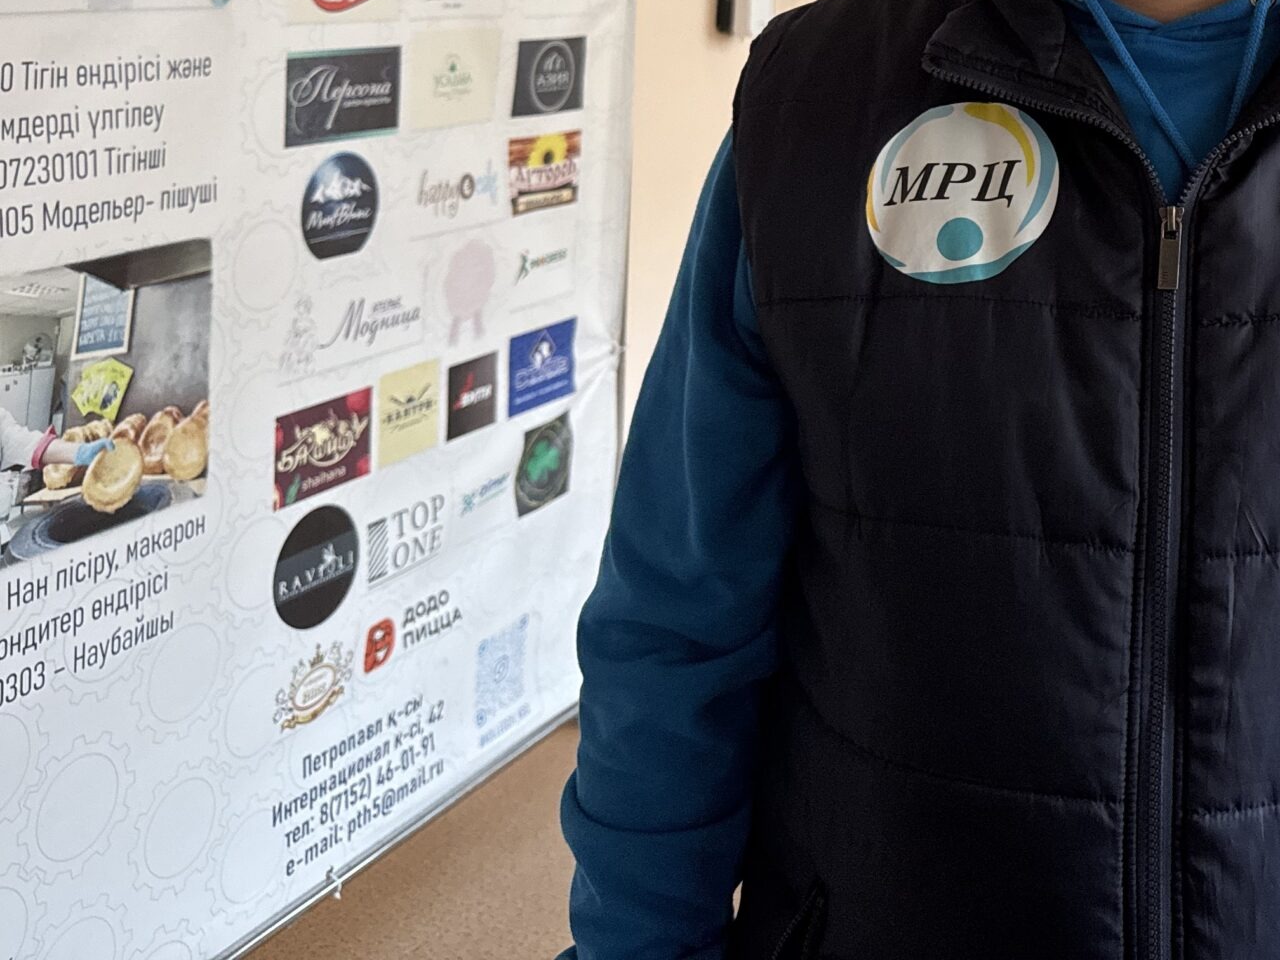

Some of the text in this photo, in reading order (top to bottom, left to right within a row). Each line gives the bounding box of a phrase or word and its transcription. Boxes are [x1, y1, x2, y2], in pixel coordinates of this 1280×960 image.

[21, 60, 68, 91] Тігін
[76, 54, 161, 90] өндірісі
[166, 56, 212, 80] және
[289, 64, 392, 131] Персона
[1, 101, 165, 144] мдерді үлгілеу
[104, 141, 167, 176] Тігінші
[884, 160, 1022, 208] МРЦ
[42, 193, 155, 231] Модельер-
[160, 176, 218, 213] пішуші
[319, 296, 421, 349] Модница
[391, 494, 445, 539] TOP
[7, 515, 206, 610] Нан пісіру, макарон
[392, 524, 444, 569] ONE
[91, 566, 169, 620] өндірісі
[402, 590, 450, 629] ДОДО
[74, 610, 174, 673] Наубайшы
[402, 608, 463, 650] ПИЦЦА
[272, 739, 390, 828] Интернационал
[429, 700, 444, 724] 42
[302, 717, 383, 780] Петропавл
[284, 731, 436, 848] тел: 8(7152) 46-01-91
[286, 759, 444, 877] e-mail: pth5@mail.ru
